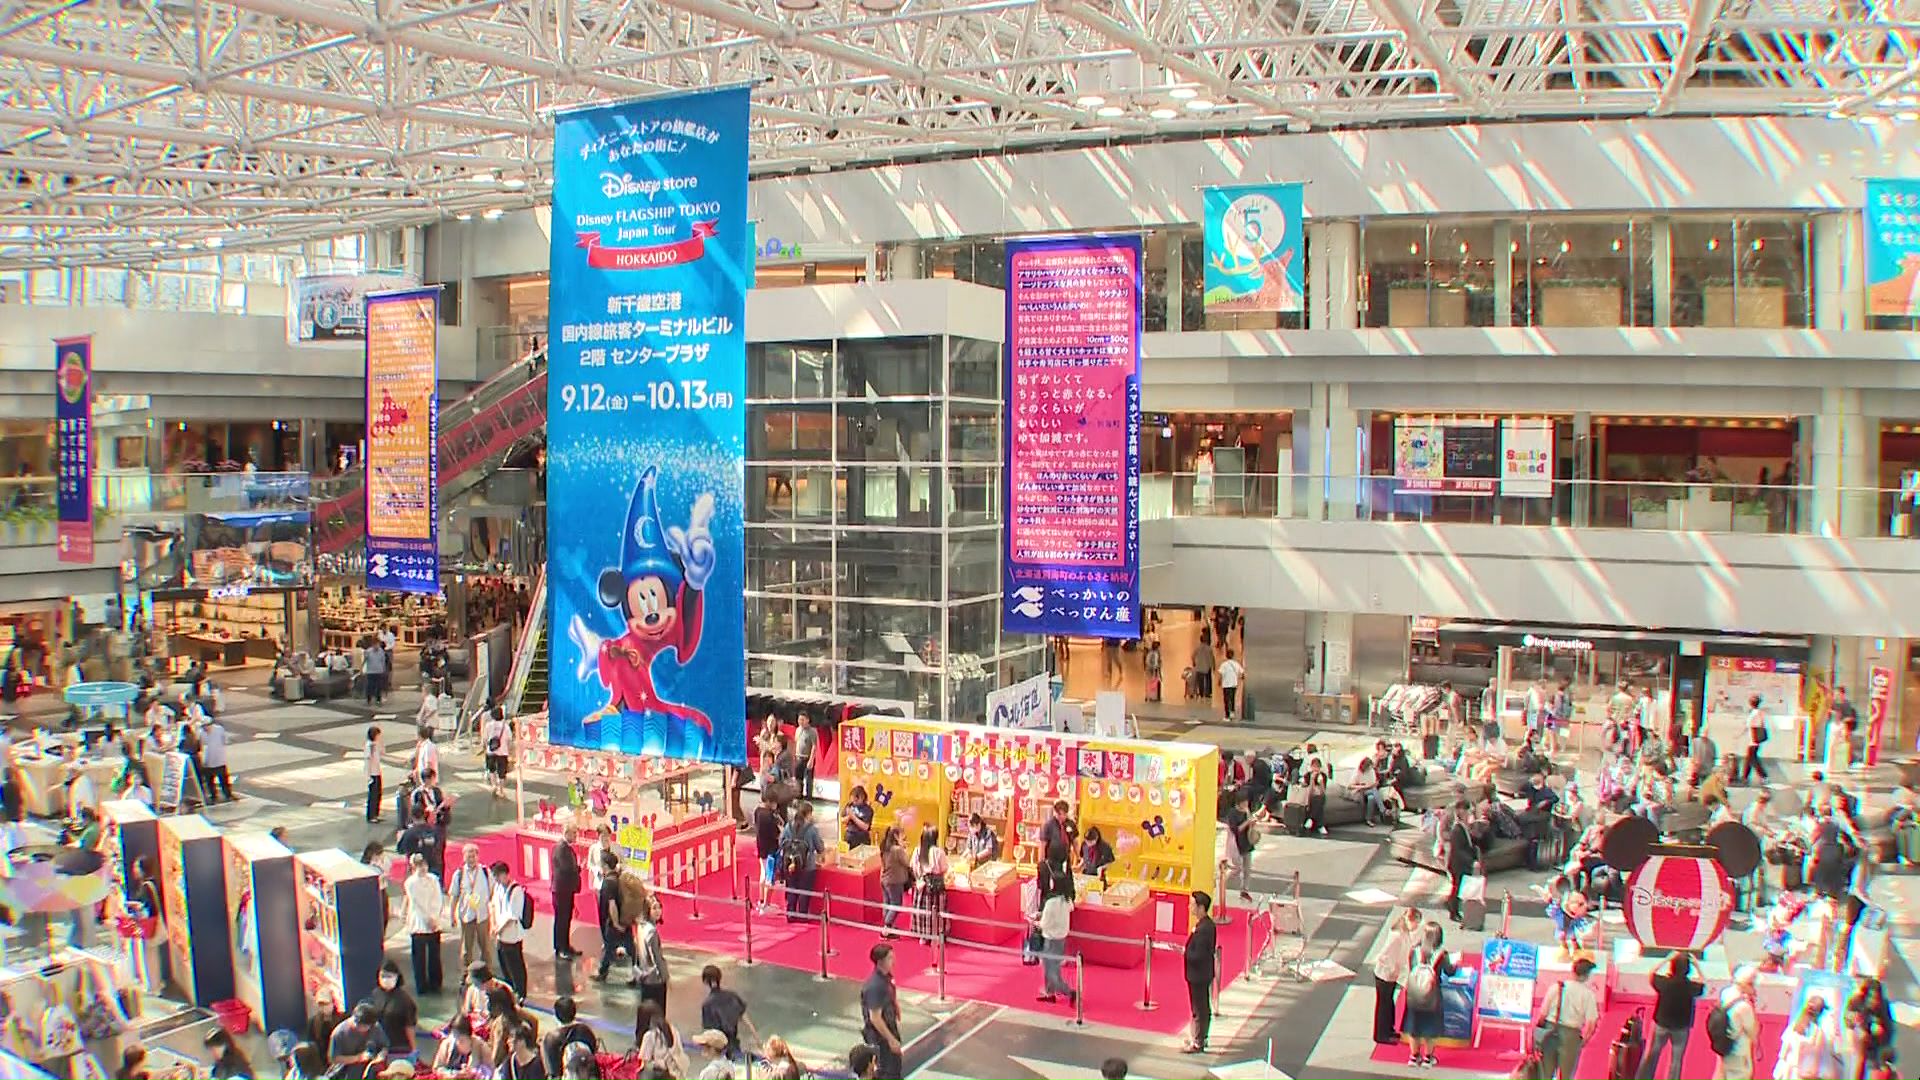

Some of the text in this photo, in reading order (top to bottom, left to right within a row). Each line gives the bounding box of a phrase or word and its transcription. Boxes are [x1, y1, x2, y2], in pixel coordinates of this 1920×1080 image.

[600, 172, 698, 202] Disney store
[576, 201, 720, 228] Disney FLAGSHIP TOKYO
[617, 224, 677, 241] Japan Tour
[616, 250, 677, 266] HOKKAIDO
[607, 291, 682, 315] 新千歳空港
[561, 316, 734, 343] 国内線旅客ターミナルビル
[579, 342, 711, 368] 2階 センタープラザ
[1017, 373, 1084, 386] 恥ずかしくて
[1019, 387, 1113, 400] ちょっと赤くなる。
[1019, 402, 1085, 415] そのくらいが
[1017, 417, 1062, 429] おいしい
[1017, 431, 1089, 444] ゆで加減です。
[1506, 449, 1548, 461] Smile
[1050, 588, 1130, 602] べっかいの
[1050, 606, 1131, 623] べっぴん産
[963, 742, 1049, 763] スマートボール
[1084, 752, 1097, 767] 氷
